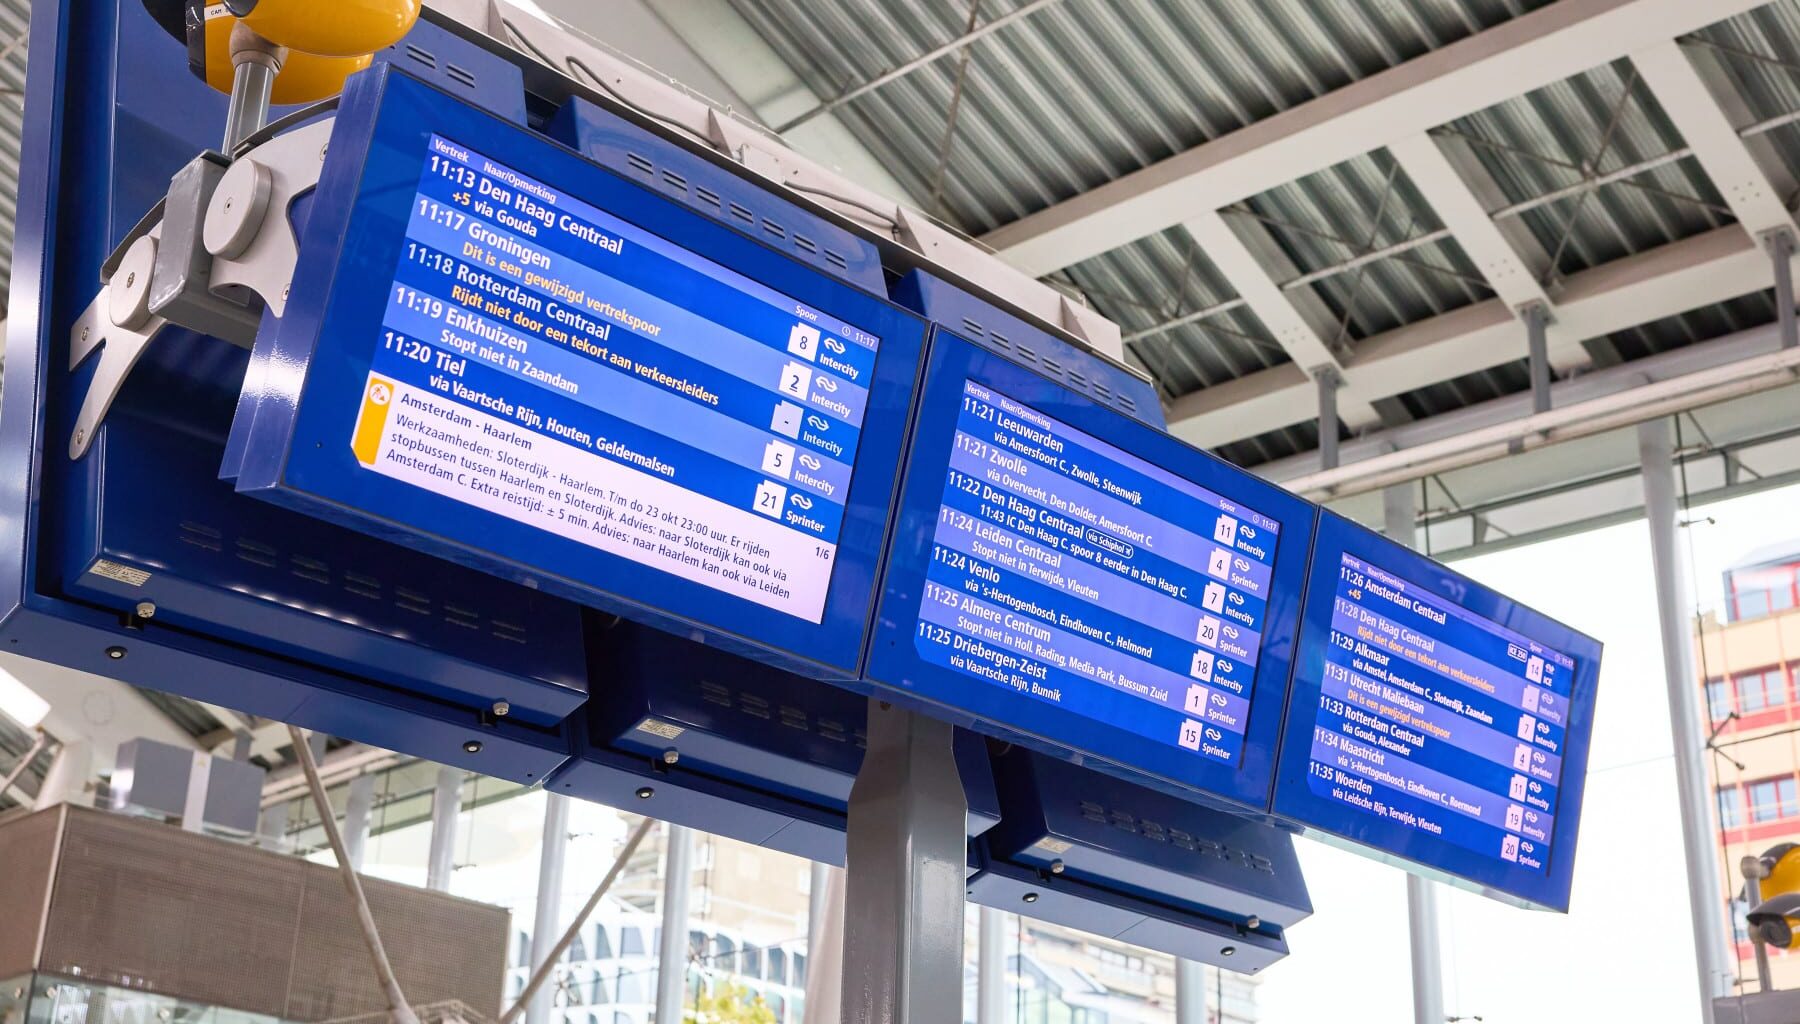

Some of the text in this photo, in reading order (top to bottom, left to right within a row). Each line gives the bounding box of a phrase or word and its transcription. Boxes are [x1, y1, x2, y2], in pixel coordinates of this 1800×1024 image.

[435, 139, 556, 204] Vertrek Naar/Opmerking
[432, 156, 623, 255] 11:13 Den Haag Centraal
[452, 192, 537, 238] +5 via Gouda
[420, 200, 550, 270] 11:17 Groningen
[409, 244, 610, 341] 11:18 Rotterdam Centraal
[463, 242, 661, 336] Dit is een gewijzigd vertrekspoor
[397, 287, 527, 354] 11:19 Enkhuizen
[795, 305, 817, 321] Spoor
[385, 332, 466, 377] 11:20 Tiel
[440, 329, 578, 394] Stopt niet in Zaandam
[452, 285, 718, 405] Rijdt niet door een tekort aan verkeersleiders
[799, 336, 808, 350] 8
[855, 333, 875, 347] 11:17
[789, 375, 799, 393] 2
[819, 353, 858, 380] Intercity
[400, 393, 532, 451] Amsterdam Haarlem
[430, 375, 674, 477] via Vaartsche Rijn, Houten, Geldermalsen
[811, 392, 850, 418] Intercity
[964, 397, 1063, 453] 11:21 Leeuwarden
[774, 453, 782, 468] 5
[803, 431, 842, 457] Intercity
[957, 434, 1027, 476] 11:21 Zwolle
[794, 470, 834, 496] Intercity
[994, 432, 1007, 445] via
[1008, 437, 1057, 467] Amersfoort
[1102, 478, 1142, 505] Steenwijk
[391, 433, 786, 582] stopbussen tussen Haarlem en Sloterdijk. Advies: naar Sloterdijk kan ook via
[761, 492, 776, 509] 21
[786, 510, 825, 533] Sprinter
[950, 472, 1084, 539] 11:22 Den Haag Centraal
[987, 469, 1000, 482] via
[1049, 494, 1066, 510] Den
[1098, 516, 1144, 543] Amersfoort
[816, 547, 829, 560] 1/6
[942, 508, 1061, 568] 11:24 Leiden Centraal
[1088, 532, 1124, 553] via Schiphol
[1236, 539, 1265, 560] Intercity
[934, 546, 1000, 583] 11:24 Venlo
[972, 541, 997, 560] Stopt
[998, 553, 1016, 568] niet
[1017, 558, 1026, 572] in
[1067, 578, 1098, 600] Vleuten
[1231, 573, 1258, 591] Sprinter
[927, 584, 1050, 642] 11:25 Almere Centrum
[965, 579, 978, 592] via
[1059, 614, 1102, 640] Eindhoven
[1116, 636, 1152, 658] Helmond
[1225, 606, 1254, 626] Intercity
[919, 622, 1047, 680] 11:25 Driebergen-Zeist
[1219, 640, 1247, 657] Sprinter
[950, 655, 964, 668] via
[966, 658, 1008, 684] Vaartsche
[1031, 682, 1061, 702] Bunnik
[1213, 674, 1242, 694] Intercity
[1208, 708, 1236, 725] Sprinter
[1202, 742, 1230, 759] Sprinter
